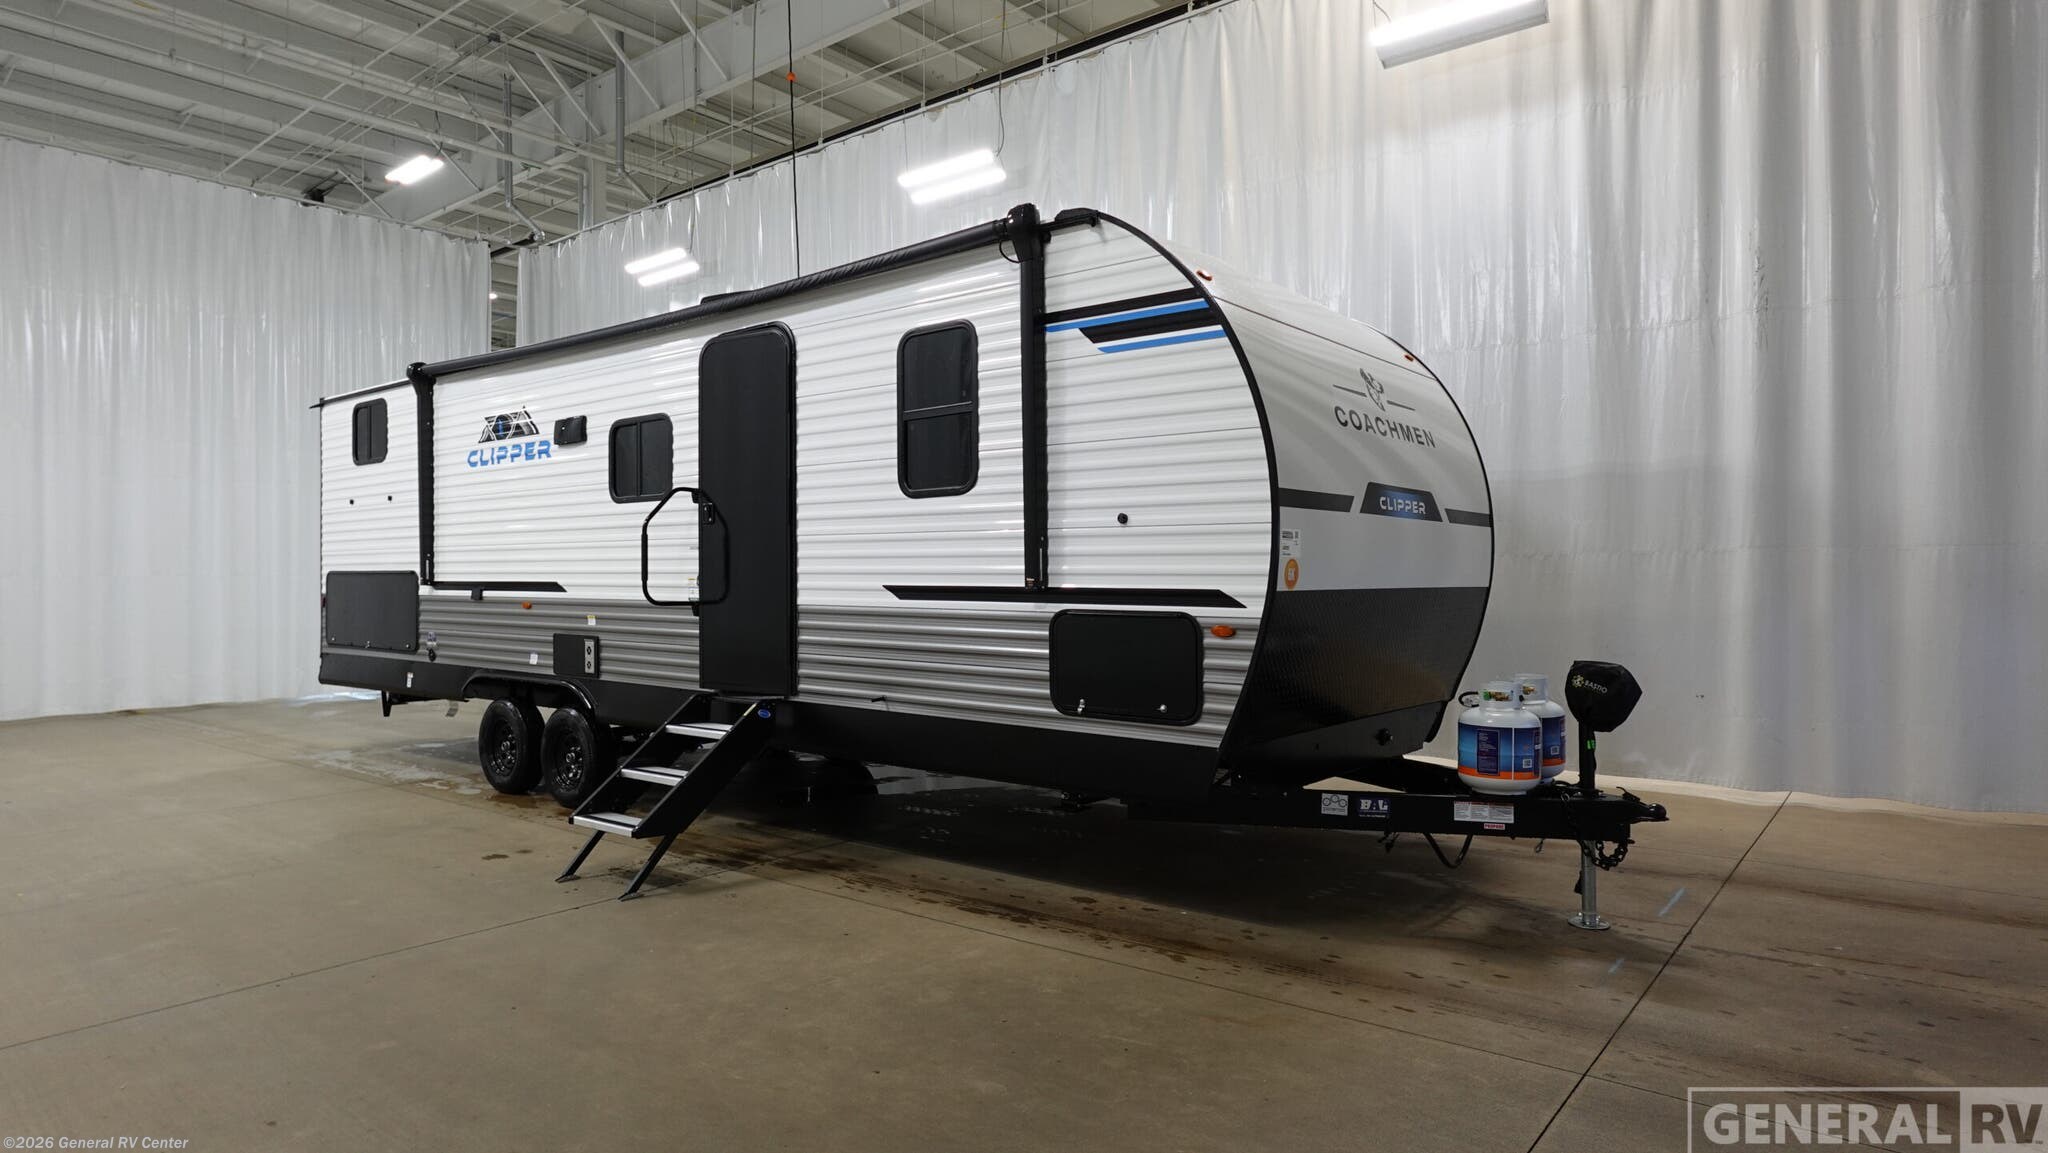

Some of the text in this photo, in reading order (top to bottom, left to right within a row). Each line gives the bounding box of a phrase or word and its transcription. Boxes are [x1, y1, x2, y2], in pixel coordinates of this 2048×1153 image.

[1334, 406, 1436, 448] COACHMEN
[467, 440, 552, 468] CLIPPER
[1379, 496, 1426, 515] CLIPPER
